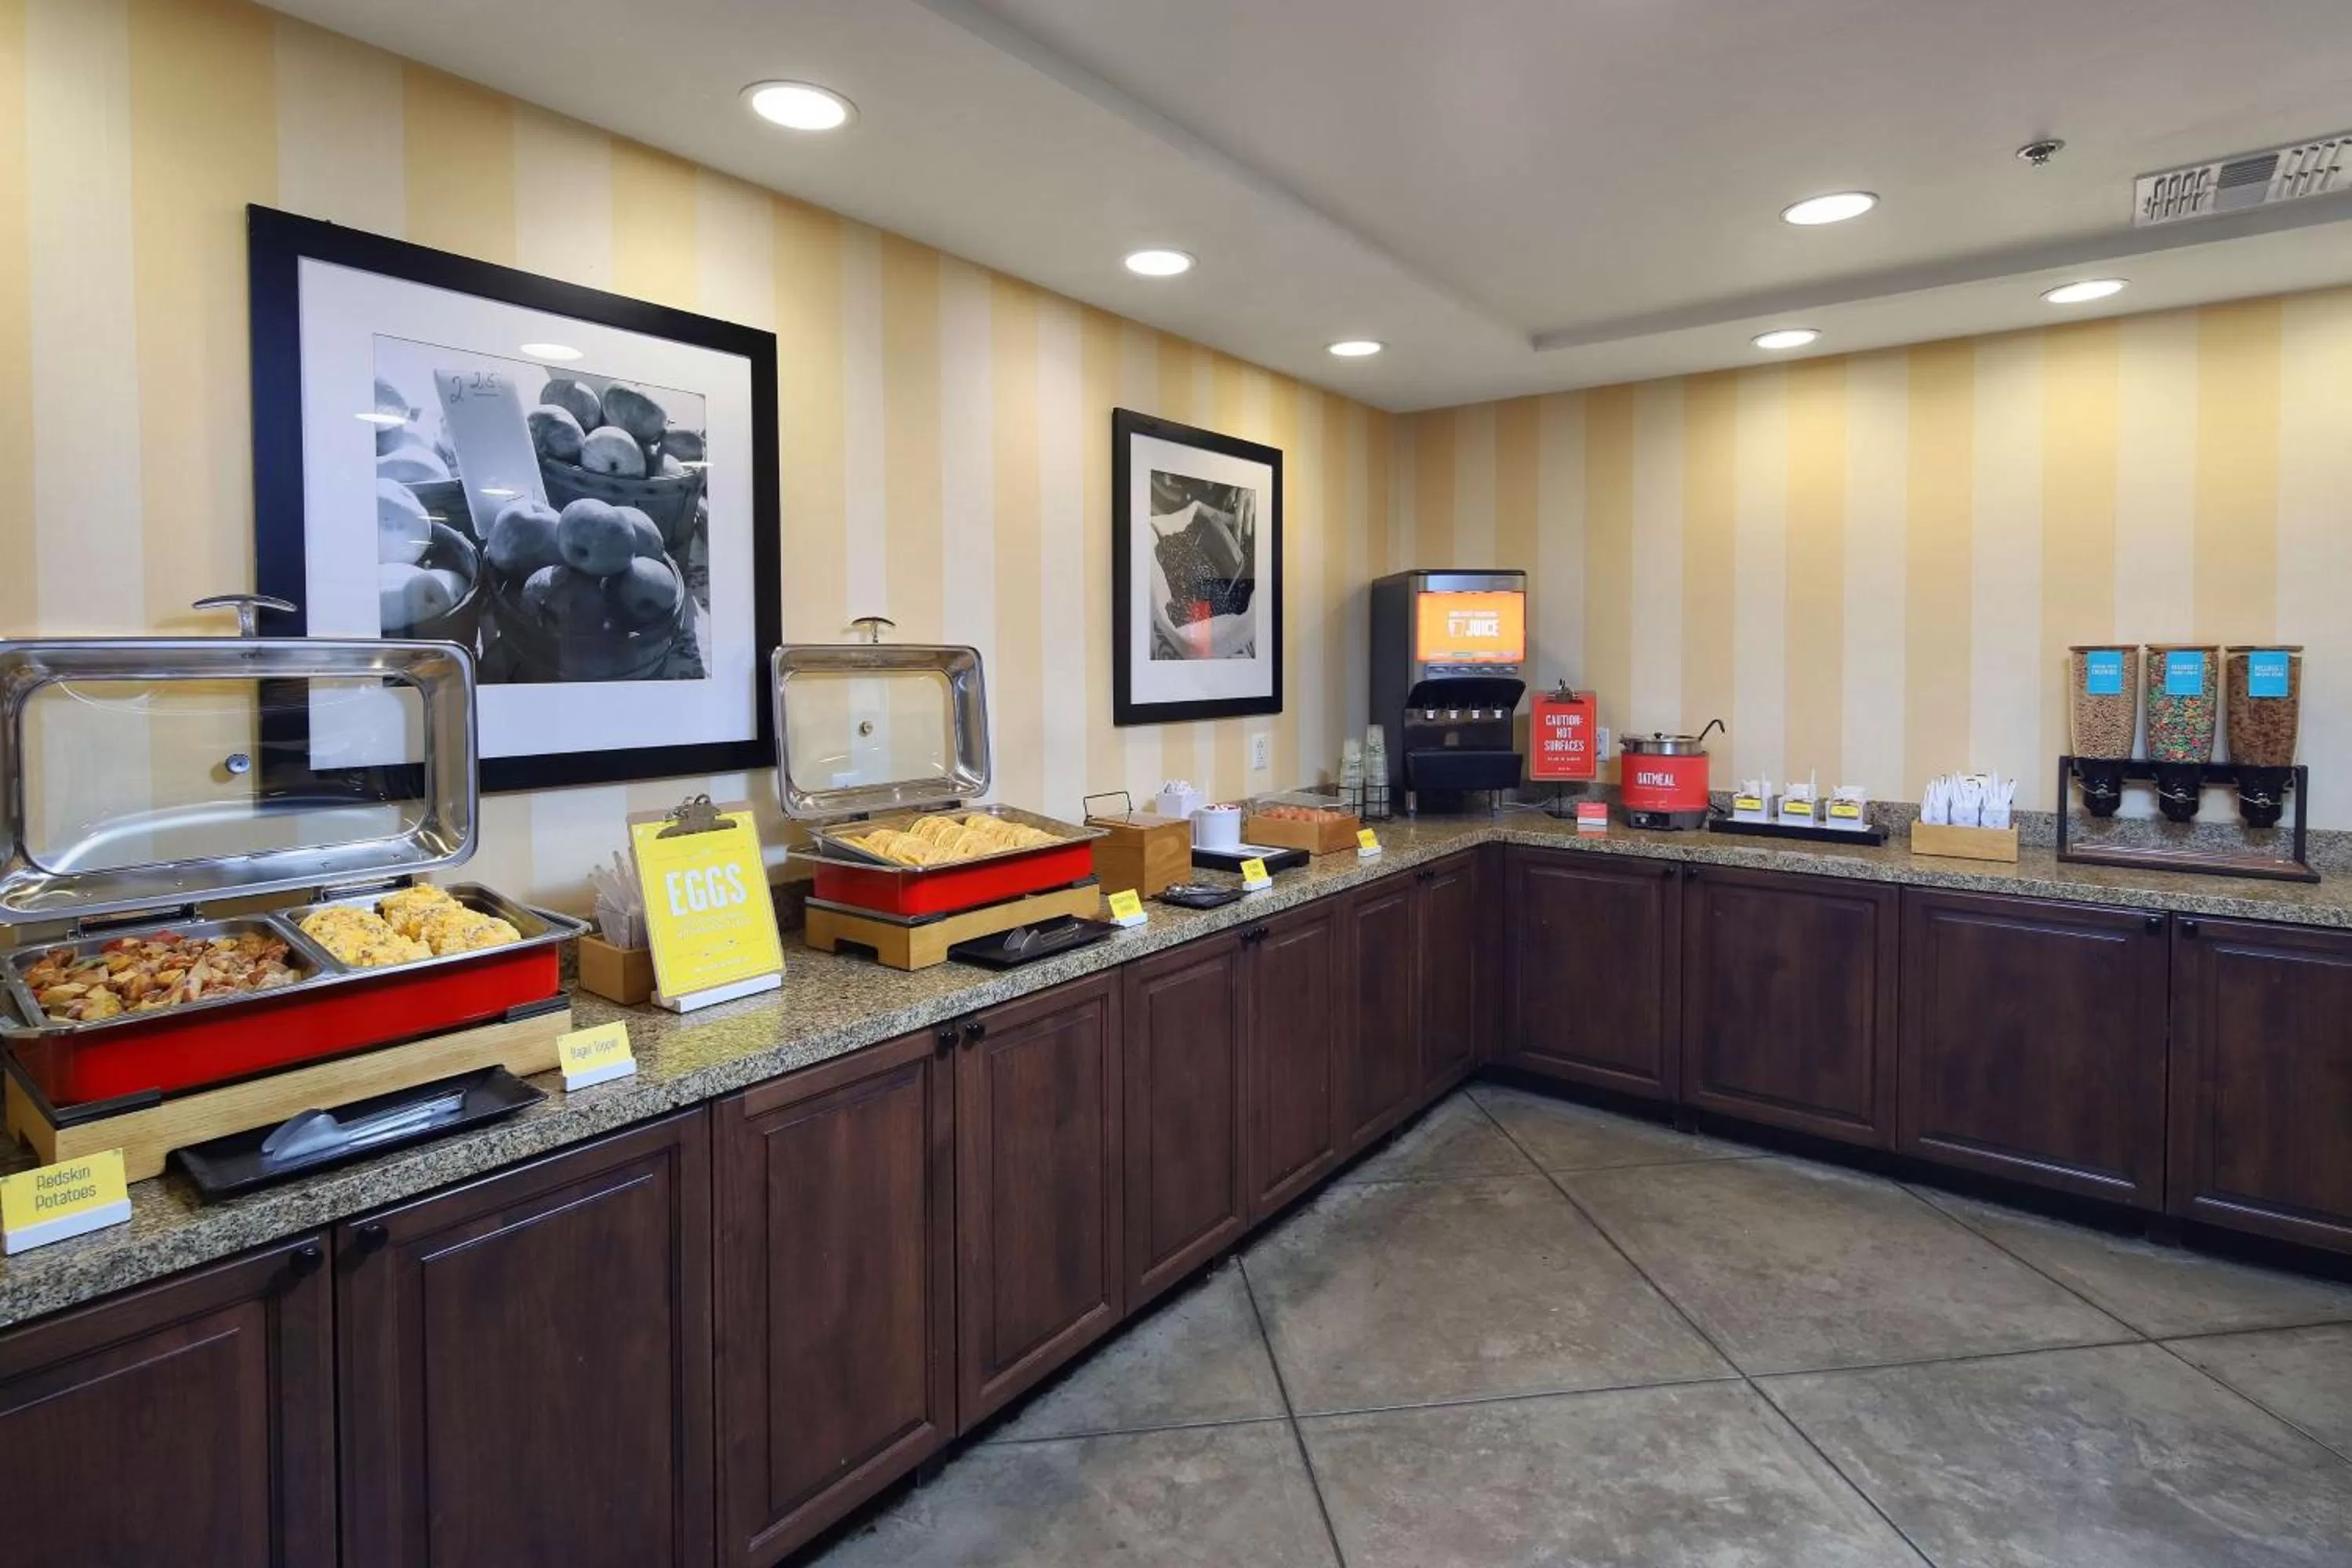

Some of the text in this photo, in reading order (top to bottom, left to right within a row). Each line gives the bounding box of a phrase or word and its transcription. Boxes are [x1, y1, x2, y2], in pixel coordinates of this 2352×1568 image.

[1465, 619, 1500, 637] JUICE
[1545, 714, 1584, 726] CAUTION:
[1556, 727, 1573, 739] HOT
[1544, 739, 1584, 752] SURFACES
[1636, 771, 1675, 786] OATMEAL
[665, 862, 747, 916] EGGS
[37, 1166, 91, 1191] Redskin
[35, 1185, 96, 1213] Potatoes
